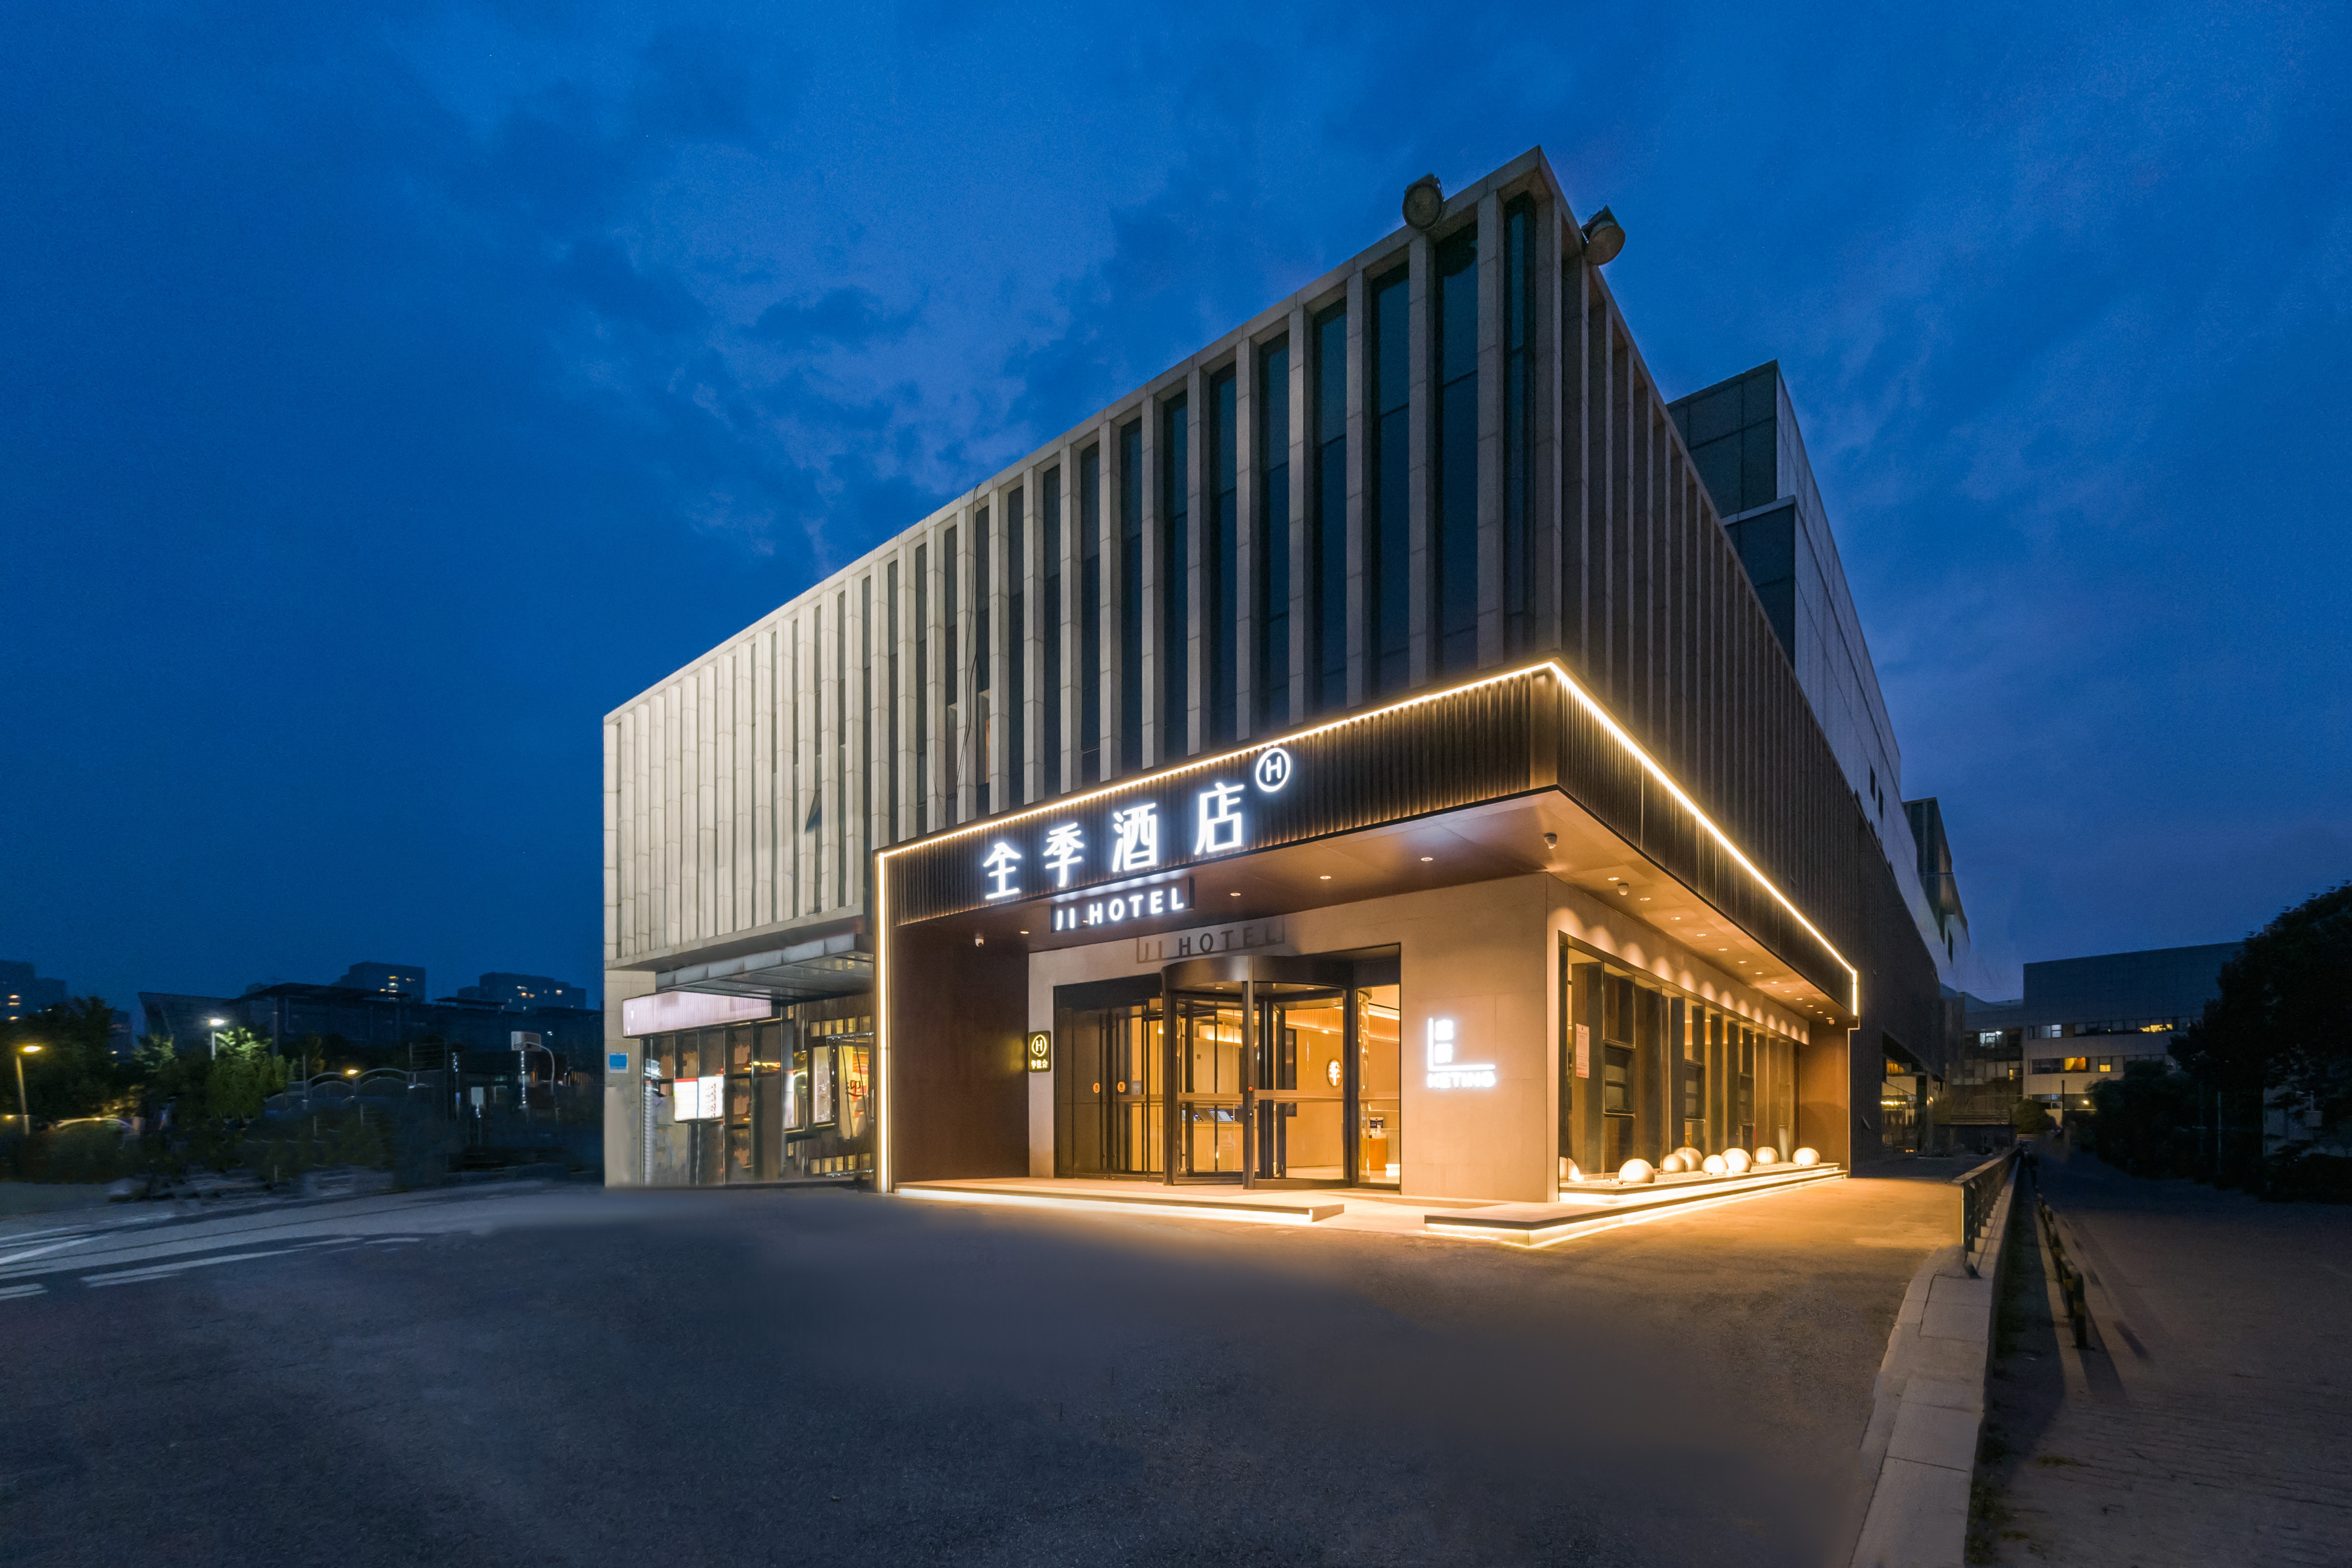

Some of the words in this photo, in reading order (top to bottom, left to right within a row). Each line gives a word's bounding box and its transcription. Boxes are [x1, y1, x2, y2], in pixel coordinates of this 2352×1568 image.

[983, 782, 1245, 900] 全季酒店
[1056, 908, 1075, 931] JI
[1088, 887, 1185, 925] HOTEL
[1178, 919, 1277, 956] HOTEL
[1427, 1071, 1495, 1088] KETING
